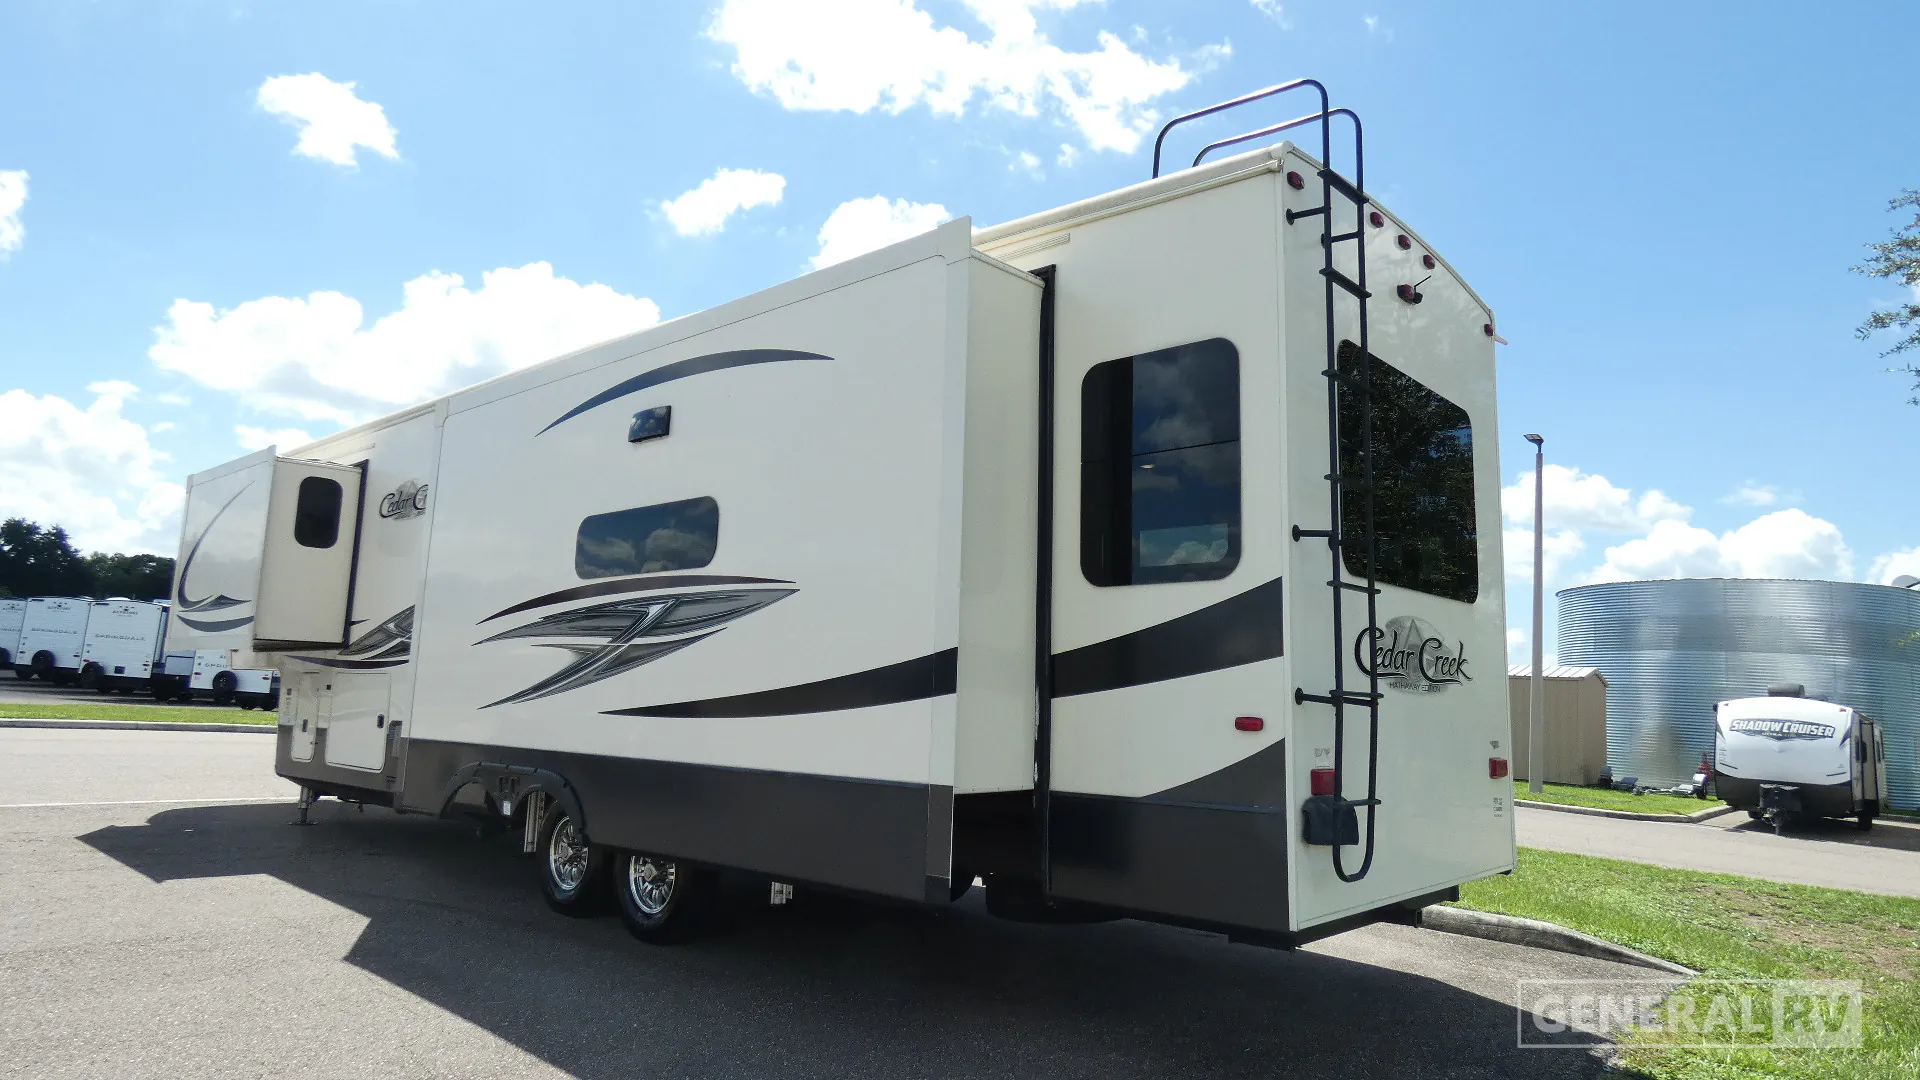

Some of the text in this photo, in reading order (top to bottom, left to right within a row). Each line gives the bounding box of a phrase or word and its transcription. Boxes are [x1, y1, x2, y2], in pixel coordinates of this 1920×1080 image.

[379, 490, 411, 518] Cedar
[1354, 626, 1473, 685] Cedar Creek
[1389, 681, 1441, 693] HATHAWAY EDITION
[1731, 720, 1782, 731] SHADOW
[1782, 721, 1835, 737] CRUISER
